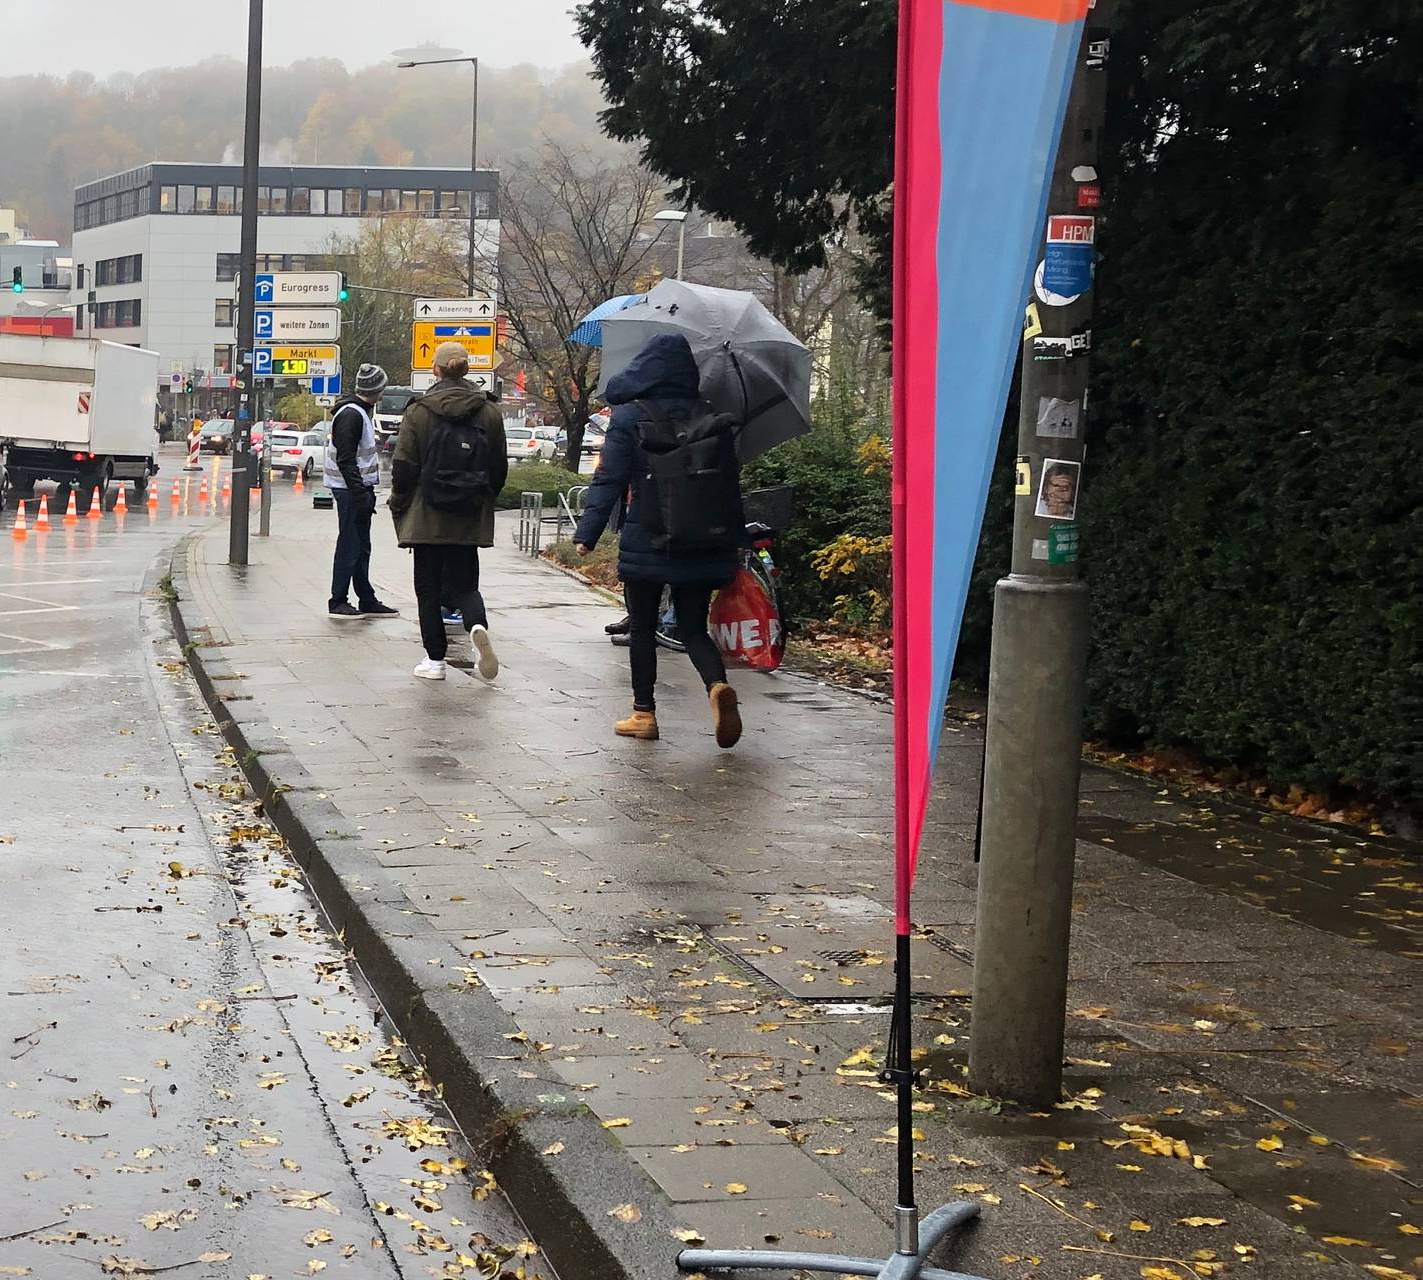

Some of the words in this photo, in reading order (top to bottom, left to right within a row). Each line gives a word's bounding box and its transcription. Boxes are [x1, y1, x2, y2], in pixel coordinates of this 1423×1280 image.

[1063, 225, 1094, 241] HPM
[281, 283, 330, 294] Eurogress
[280, 321, 306, 329] weitere
[309, 321, 330, 329] Zonen
[290, 348, 317, 358] Markt
[282, 360, 307, 374] 130
